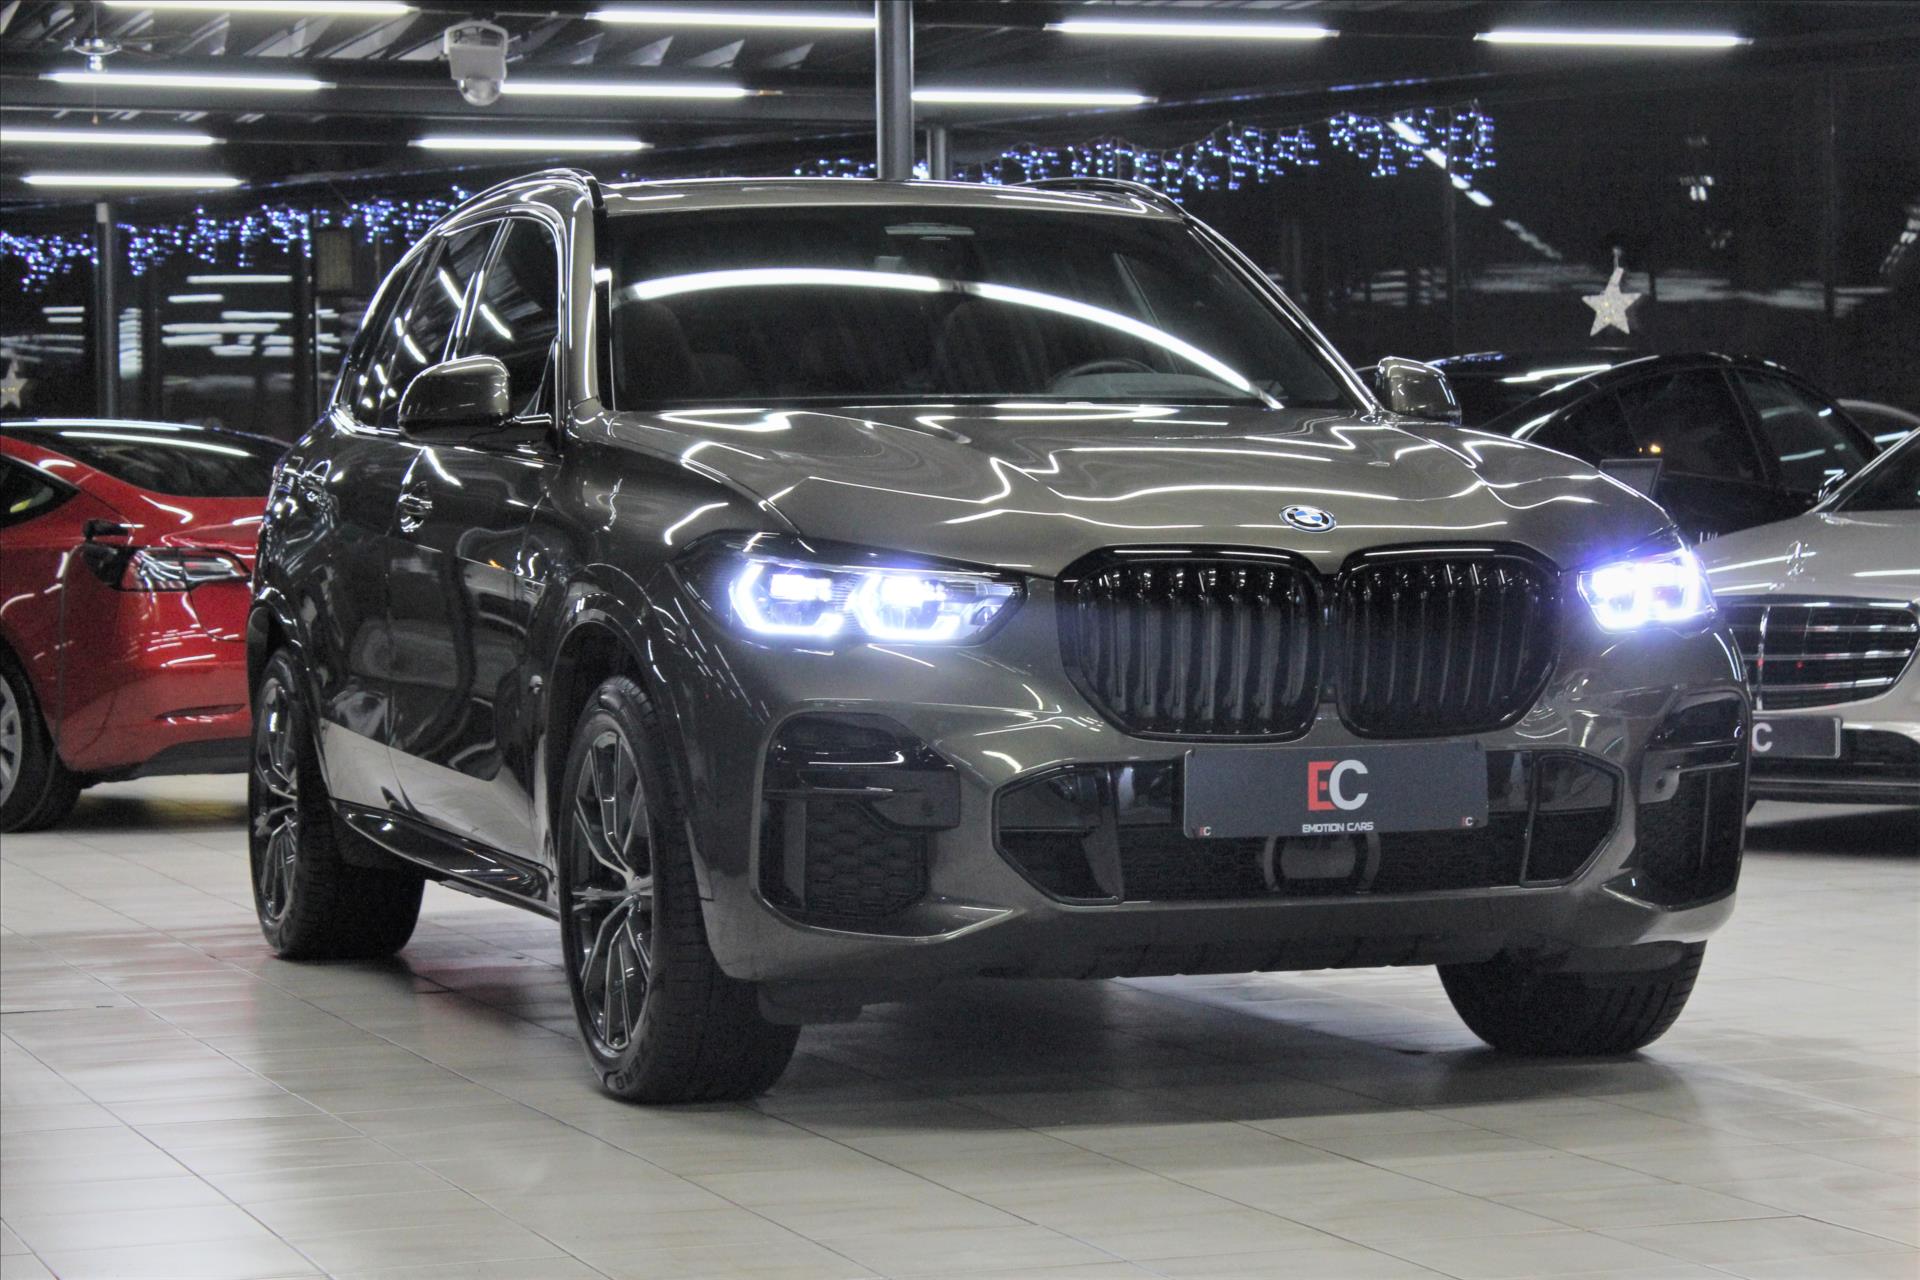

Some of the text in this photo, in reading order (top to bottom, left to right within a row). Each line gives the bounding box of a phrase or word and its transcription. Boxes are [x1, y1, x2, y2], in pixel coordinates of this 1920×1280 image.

[1752, 722, 1773, 752] C
[1308, 759, 1368, 811] EC
[1302, 821, 1374, 833] EMOTION CARS
